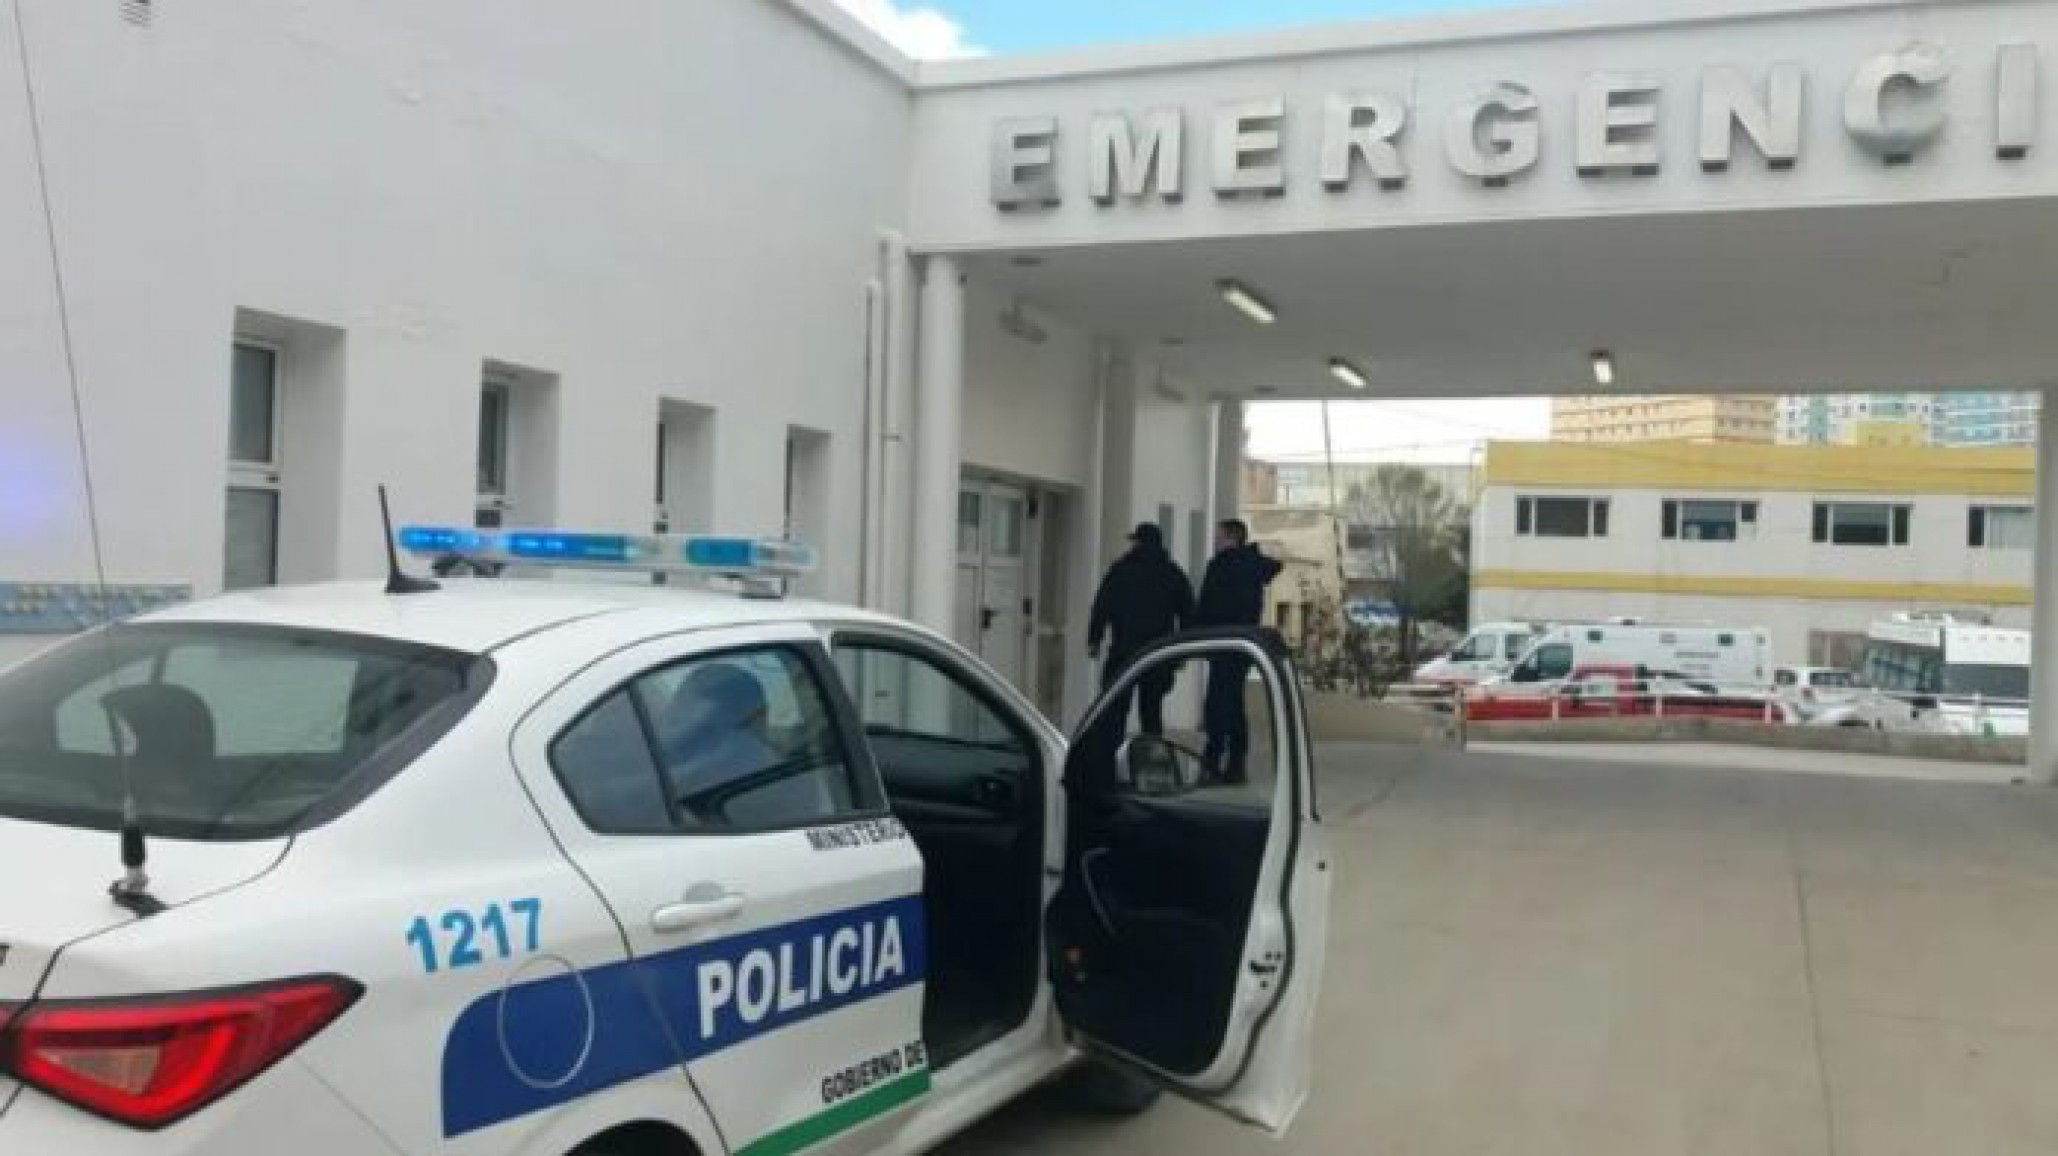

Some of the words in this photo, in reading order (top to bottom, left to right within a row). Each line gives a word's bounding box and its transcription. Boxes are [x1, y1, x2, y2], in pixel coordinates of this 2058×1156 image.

[990, 40, 2038, 210] EMERGENCI
[404, 897, 542, 973] 1217
[697, 915, 906, 1038] POLICIA
[821, 1048, 903, 1104] GOBIERNO
[904, 1040, 925, 1068] DE
